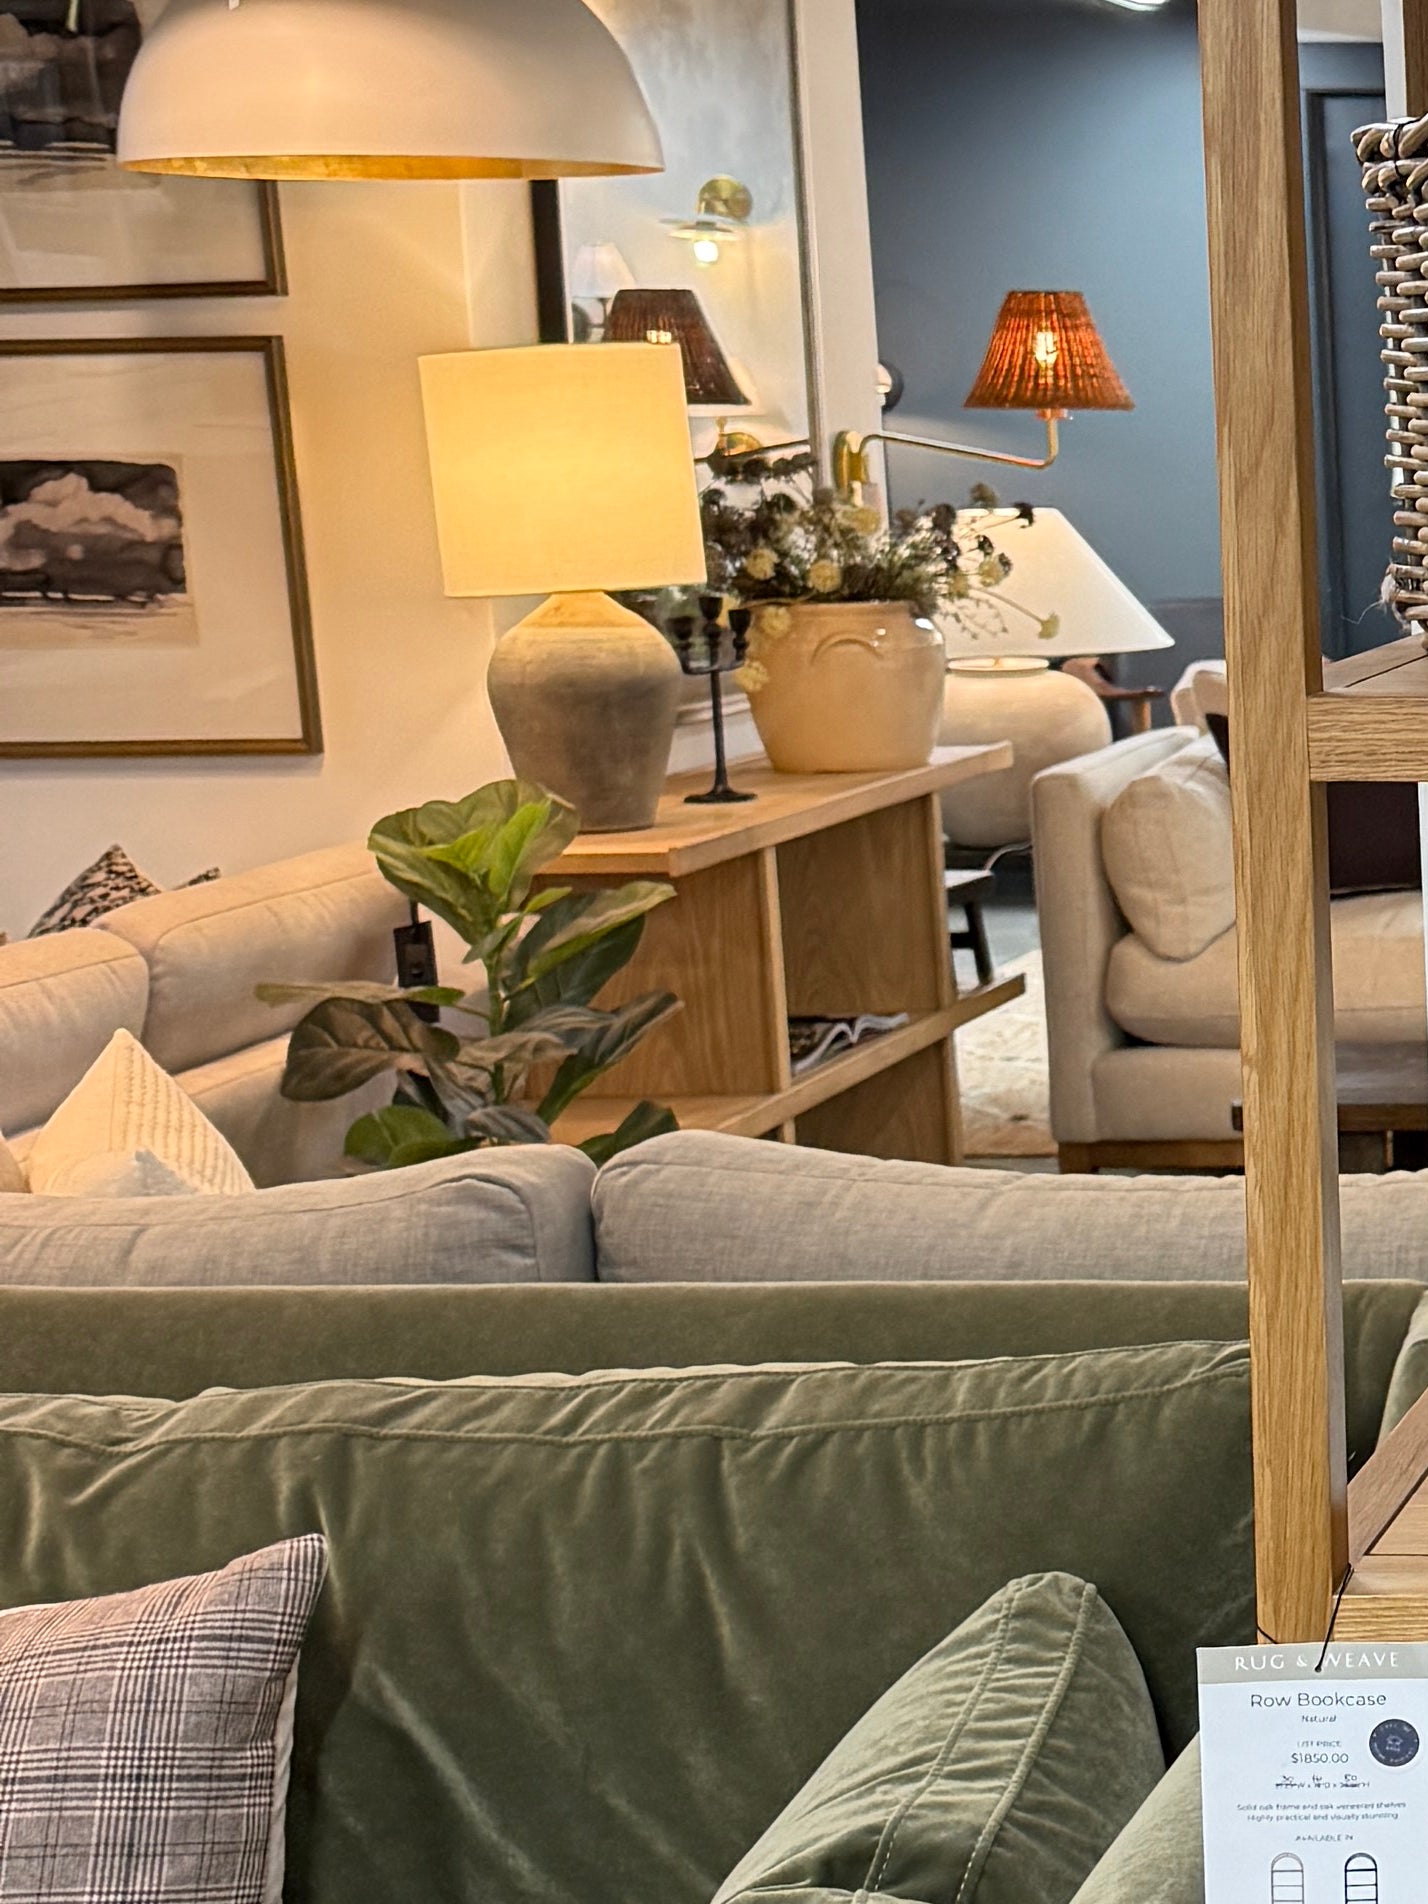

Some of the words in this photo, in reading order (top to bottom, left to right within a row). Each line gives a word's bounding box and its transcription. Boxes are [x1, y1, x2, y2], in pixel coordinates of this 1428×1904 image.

[1235, 1654, 1285, 1671] RUG
[1296, 1654, 1308, 1668] &
[1321, 1651, 1400, 1668] WEAVE
[1250, 1693, 1291, 1708] Row
[1297, 1691, 1387, 1707] Bookcase
[1291, 1752, 1349, 1764] $1850.00
